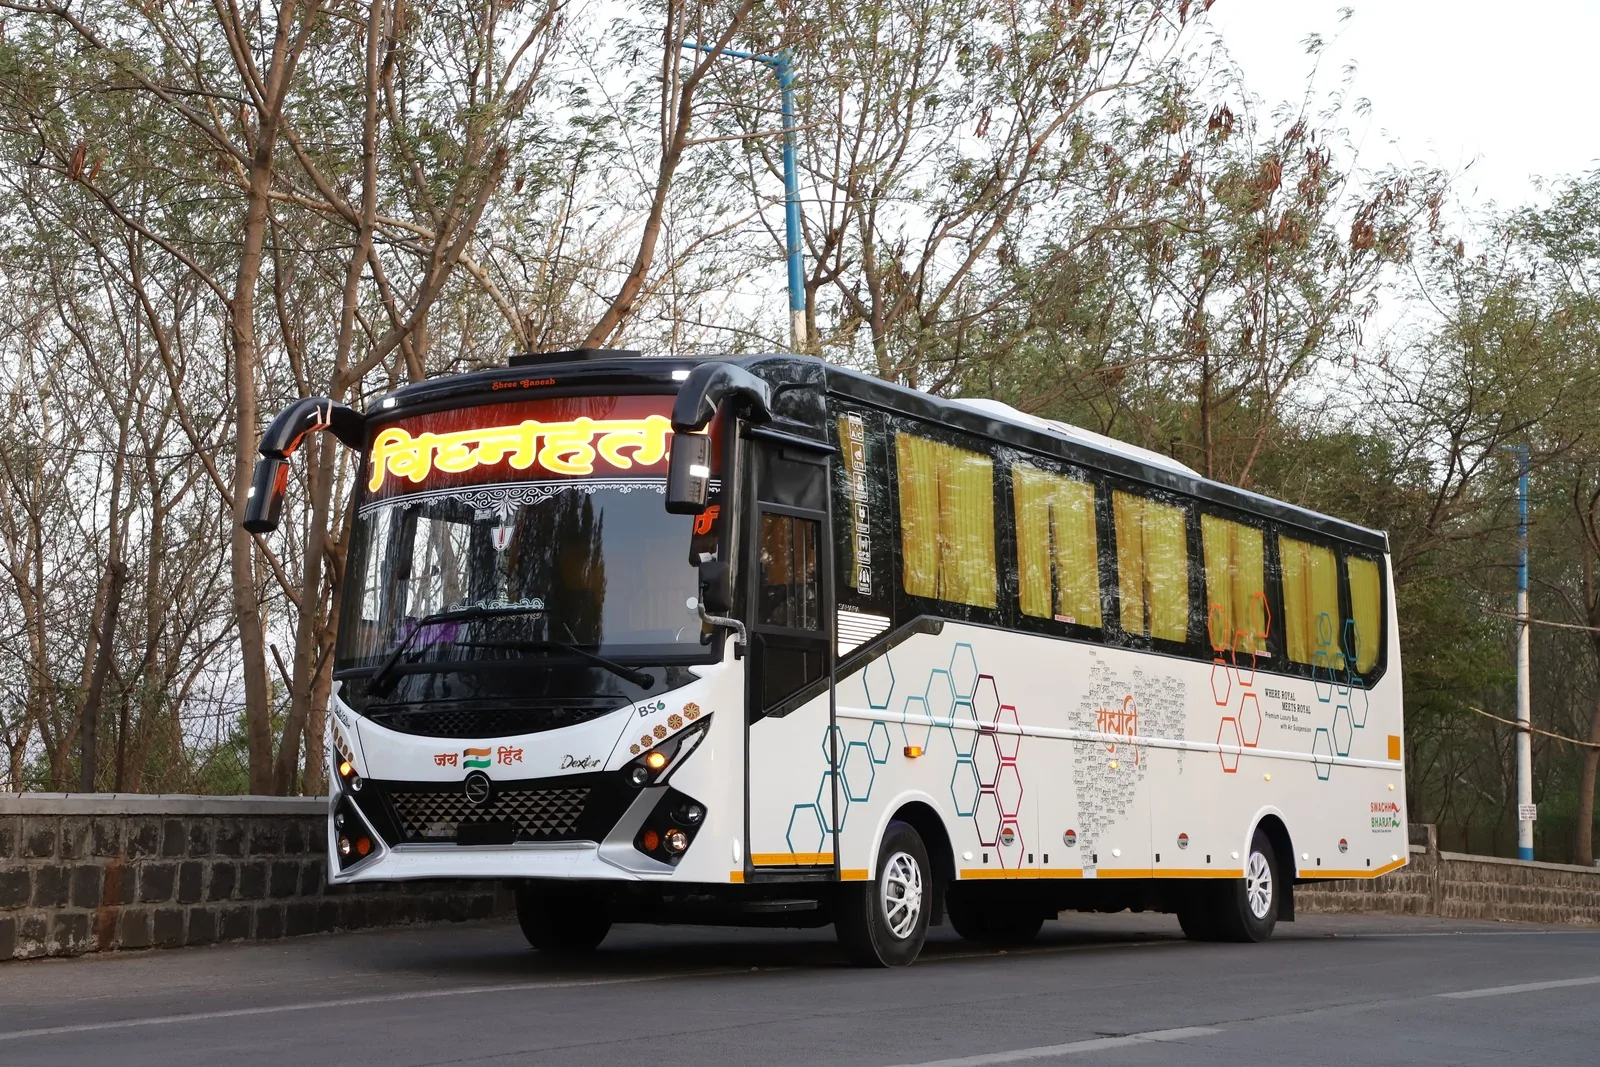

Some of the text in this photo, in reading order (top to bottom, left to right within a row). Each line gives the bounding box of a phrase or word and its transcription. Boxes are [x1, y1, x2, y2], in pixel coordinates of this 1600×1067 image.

[492, 381, 518, 390] Shree
[1265, 688, 1296, 701] WHERE ROYAL
[638, 700, 666, 717] BS6
[1282, 702, 1311, 714] MEETS ROYAL
[1265, 711, 1279, 719] Premium
[1280, 714, 1291, 722] Luxury
[434, 745, 523, 767] जय हिंद
